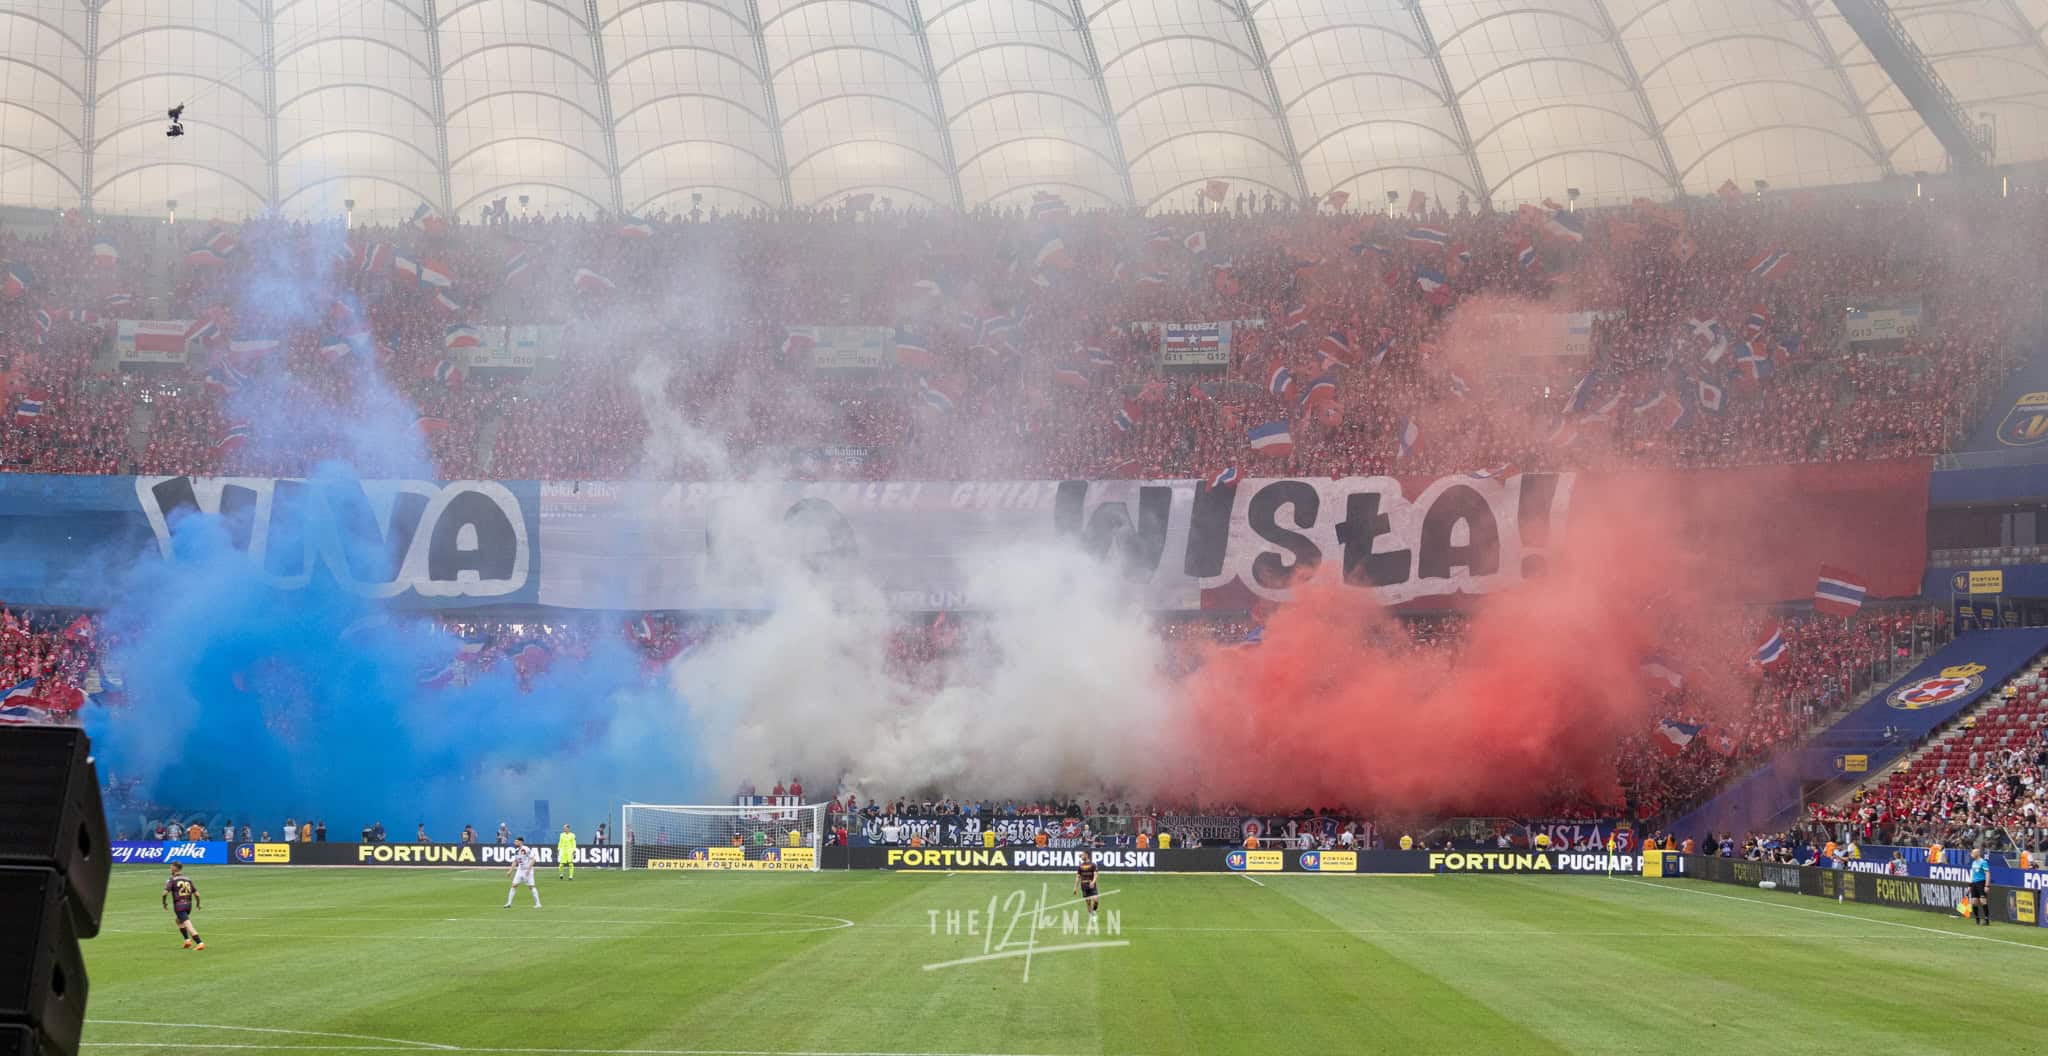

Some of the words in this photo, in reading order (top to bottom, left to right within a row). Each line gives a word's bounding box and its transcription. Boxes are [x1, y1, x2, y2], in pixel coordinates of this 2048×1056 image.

[1207, 353, 1226, 361] G12
[1054, 475, 1573, 602] WISŁA!
[134, 847, 163, 858] nas
[163, 843, 206, 862] piłka
[359, 845, 476, 863] FORTUNA
[482, 847, 553, 863] PUCAR
[558, 847, 619, 864] OLSKI
[888, 850, 1008, 866] FORTUNA
[1013, 851, 1084, 867] PUCHAR
[1092, 852, 1155, 868] POLSKI
[1429, 854, 1551, 870] FORTUNA
[1558, 855, 1633, 872] PUCHAR
[1876, 878, 1920, 904] FORTUNA
[1921, 882, 1950, 907] PUCHAR
